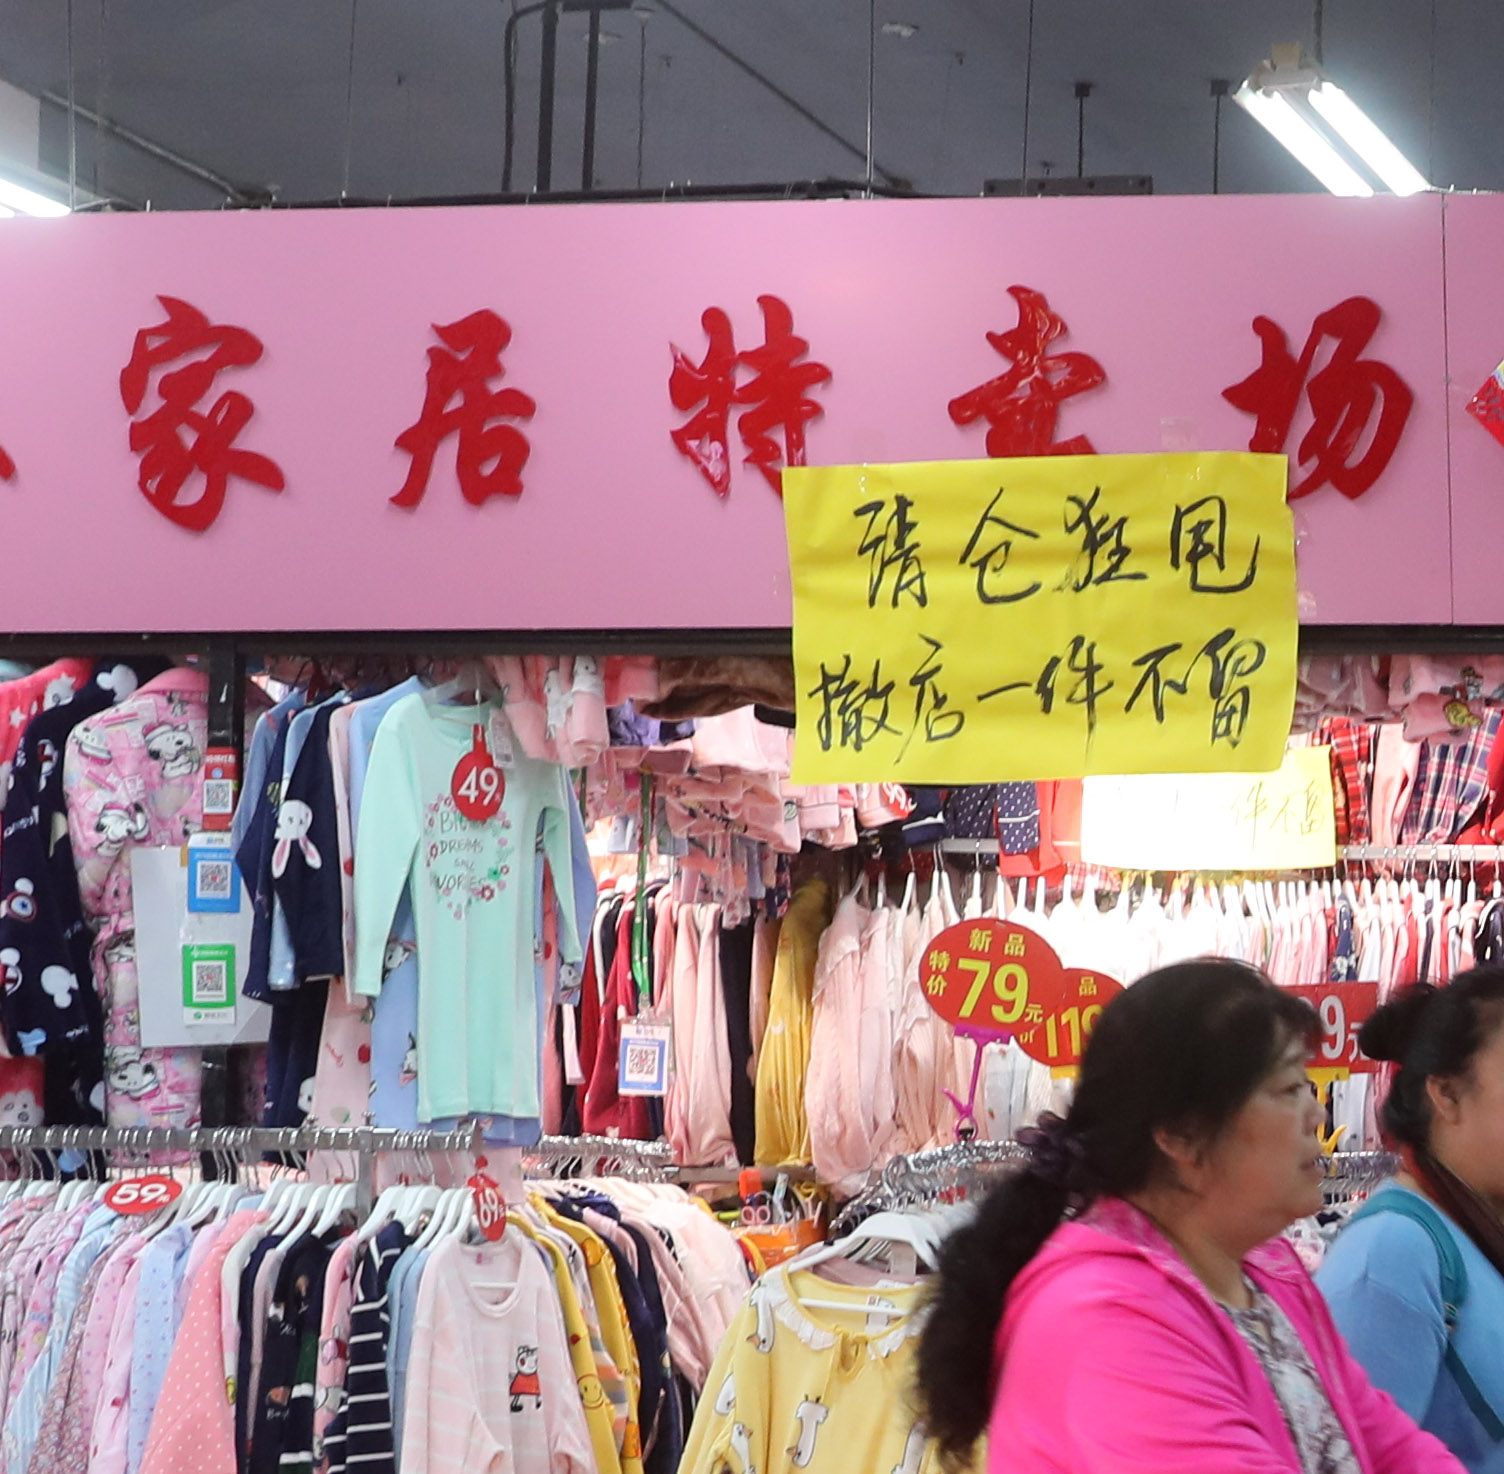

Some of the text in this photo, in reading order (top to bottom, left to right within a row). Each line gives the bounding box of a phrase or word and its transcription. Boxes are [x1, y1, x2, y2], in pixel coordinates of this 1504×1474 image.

[0, 285, 1413, 532] 家居特卖场
[809, 628, 1267, 765] 撤店一件不留
[926, 949, 951, 997] 特价
[968, 928, 1025, 957] 新品
